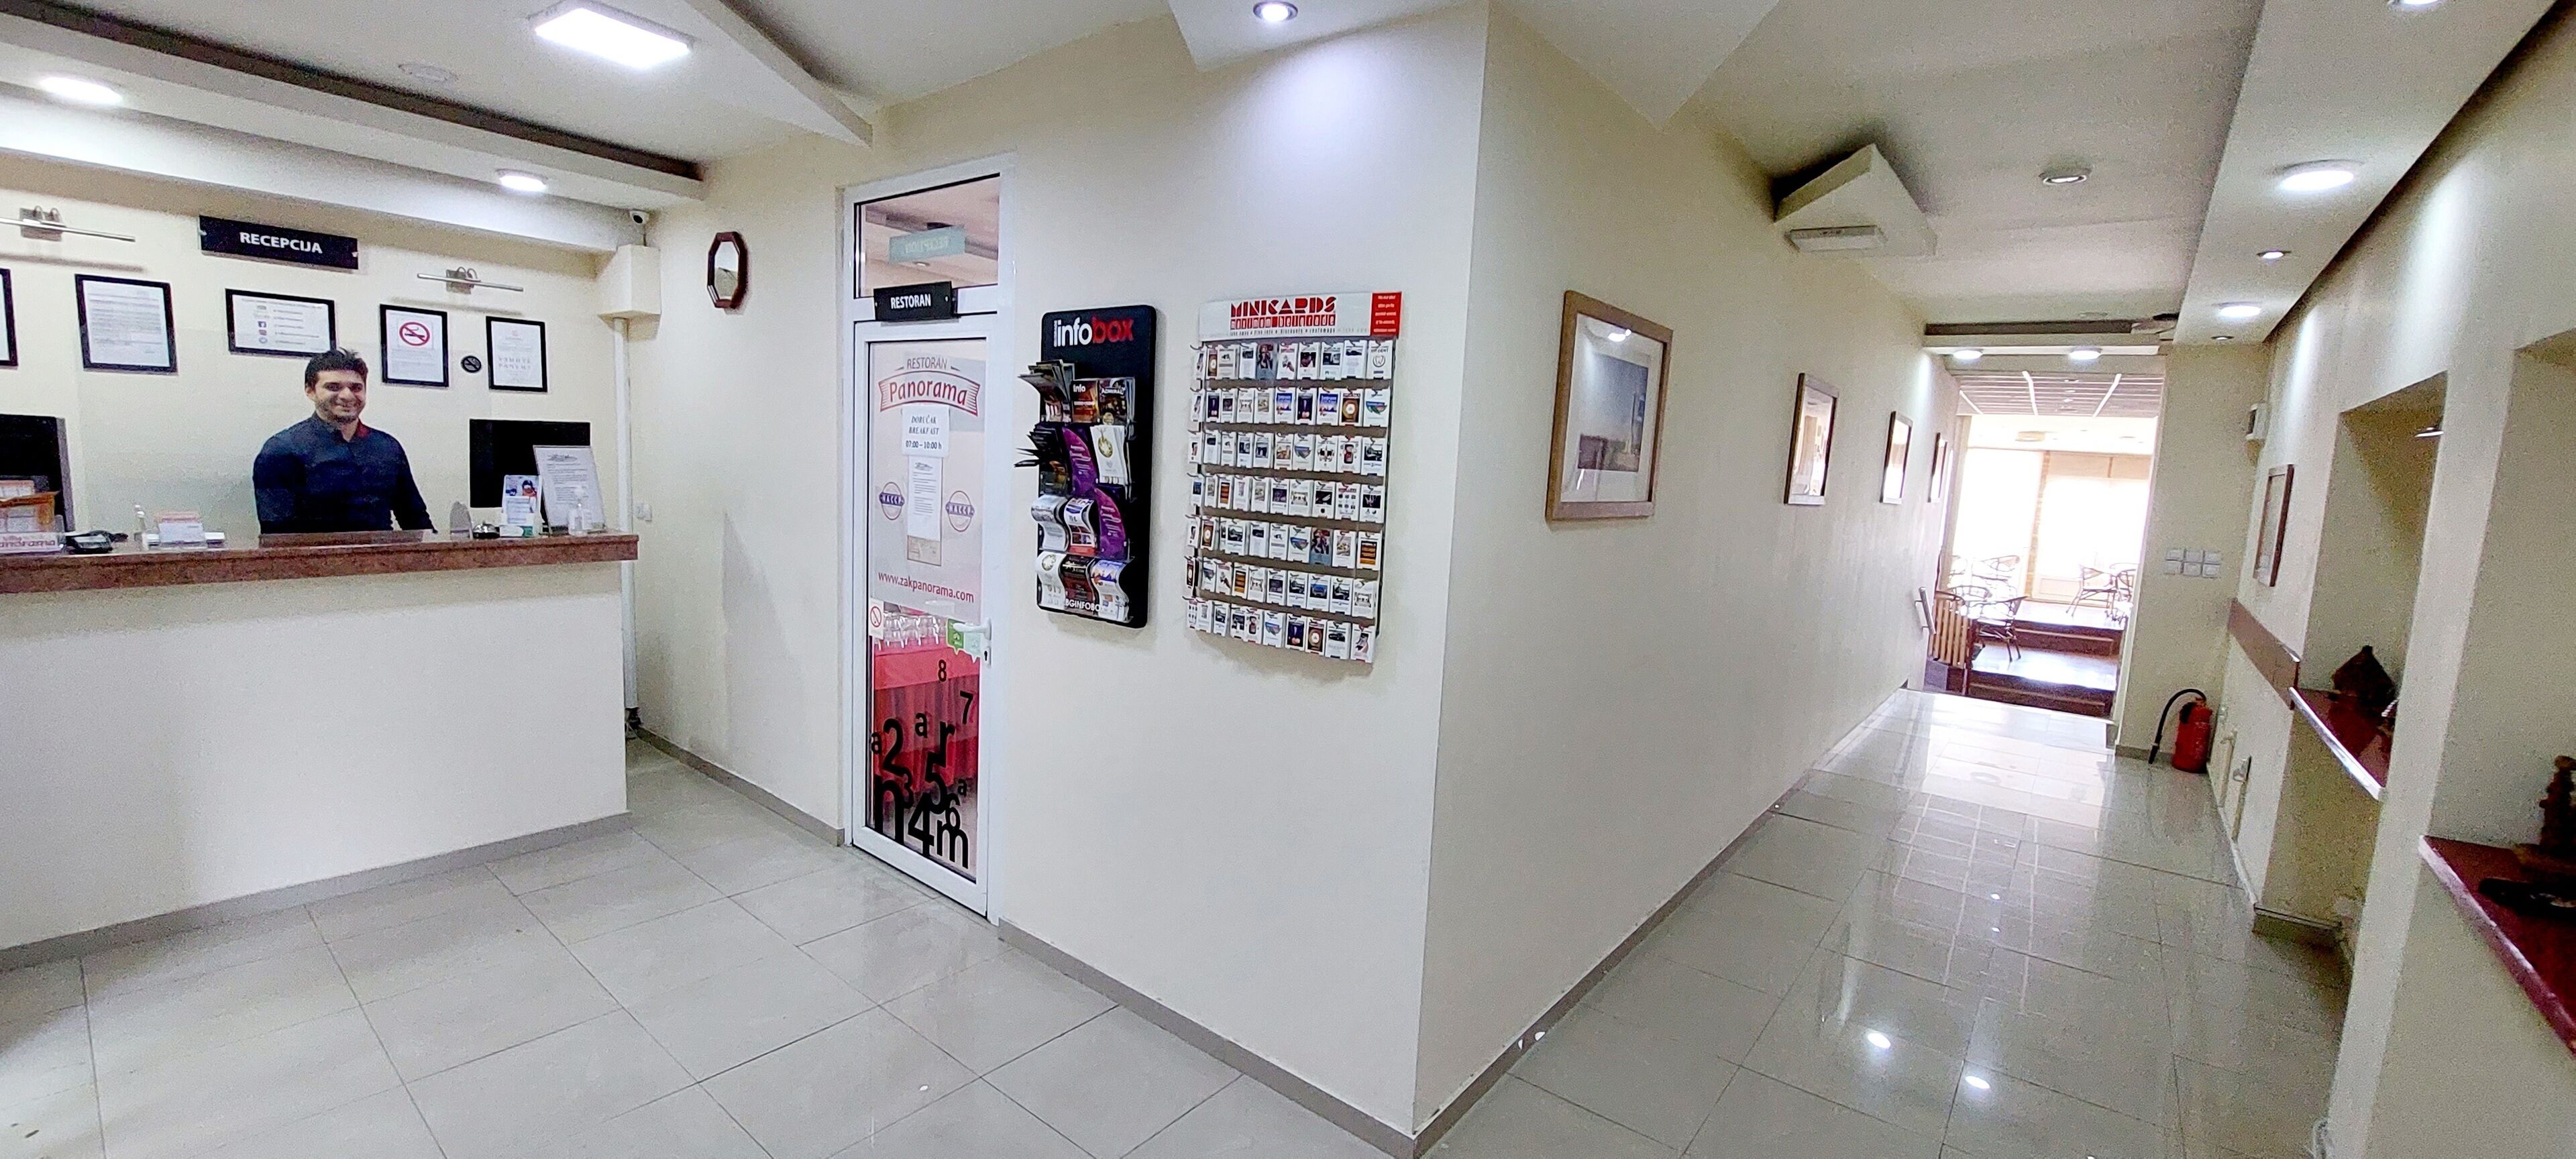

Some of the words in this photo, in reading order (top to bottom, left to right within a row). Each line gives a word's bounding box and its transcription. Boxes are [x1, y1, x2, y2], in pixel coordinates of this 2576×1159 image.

[239, 231, 323, 254] RECEPCIJA
[890, 293, 931, 309] RESTORAN
[1231, 296, 1337, 317] MINICARDS
[1057, 315, 1134, 347] infobox
[907, 357, 947, 370] RESTORAN
[890, 380, 968, 406] Panorama
[909, 427, 939, 435] BREAKFAST
[906, 440, 919, 448] 07:00
[924, 441, 938, 449] 10:00
[878, 572, 975, 603] www.zakpanorama.com
[938, 659, 947, 681] 8
[960, 690, 973, 724] 7
[915, 713, 928, 738] a
[871, 731, 882, 754] a
[883, 718, 909, 775] 2
[940, 721, 955, 767] r
[924, 751, 947, 814] 5
[957, 778, 967, 796] a
[874, 775, 904, 845] n
[908, 792, 934, 857] 4
[936, 819, 969, 869] m
